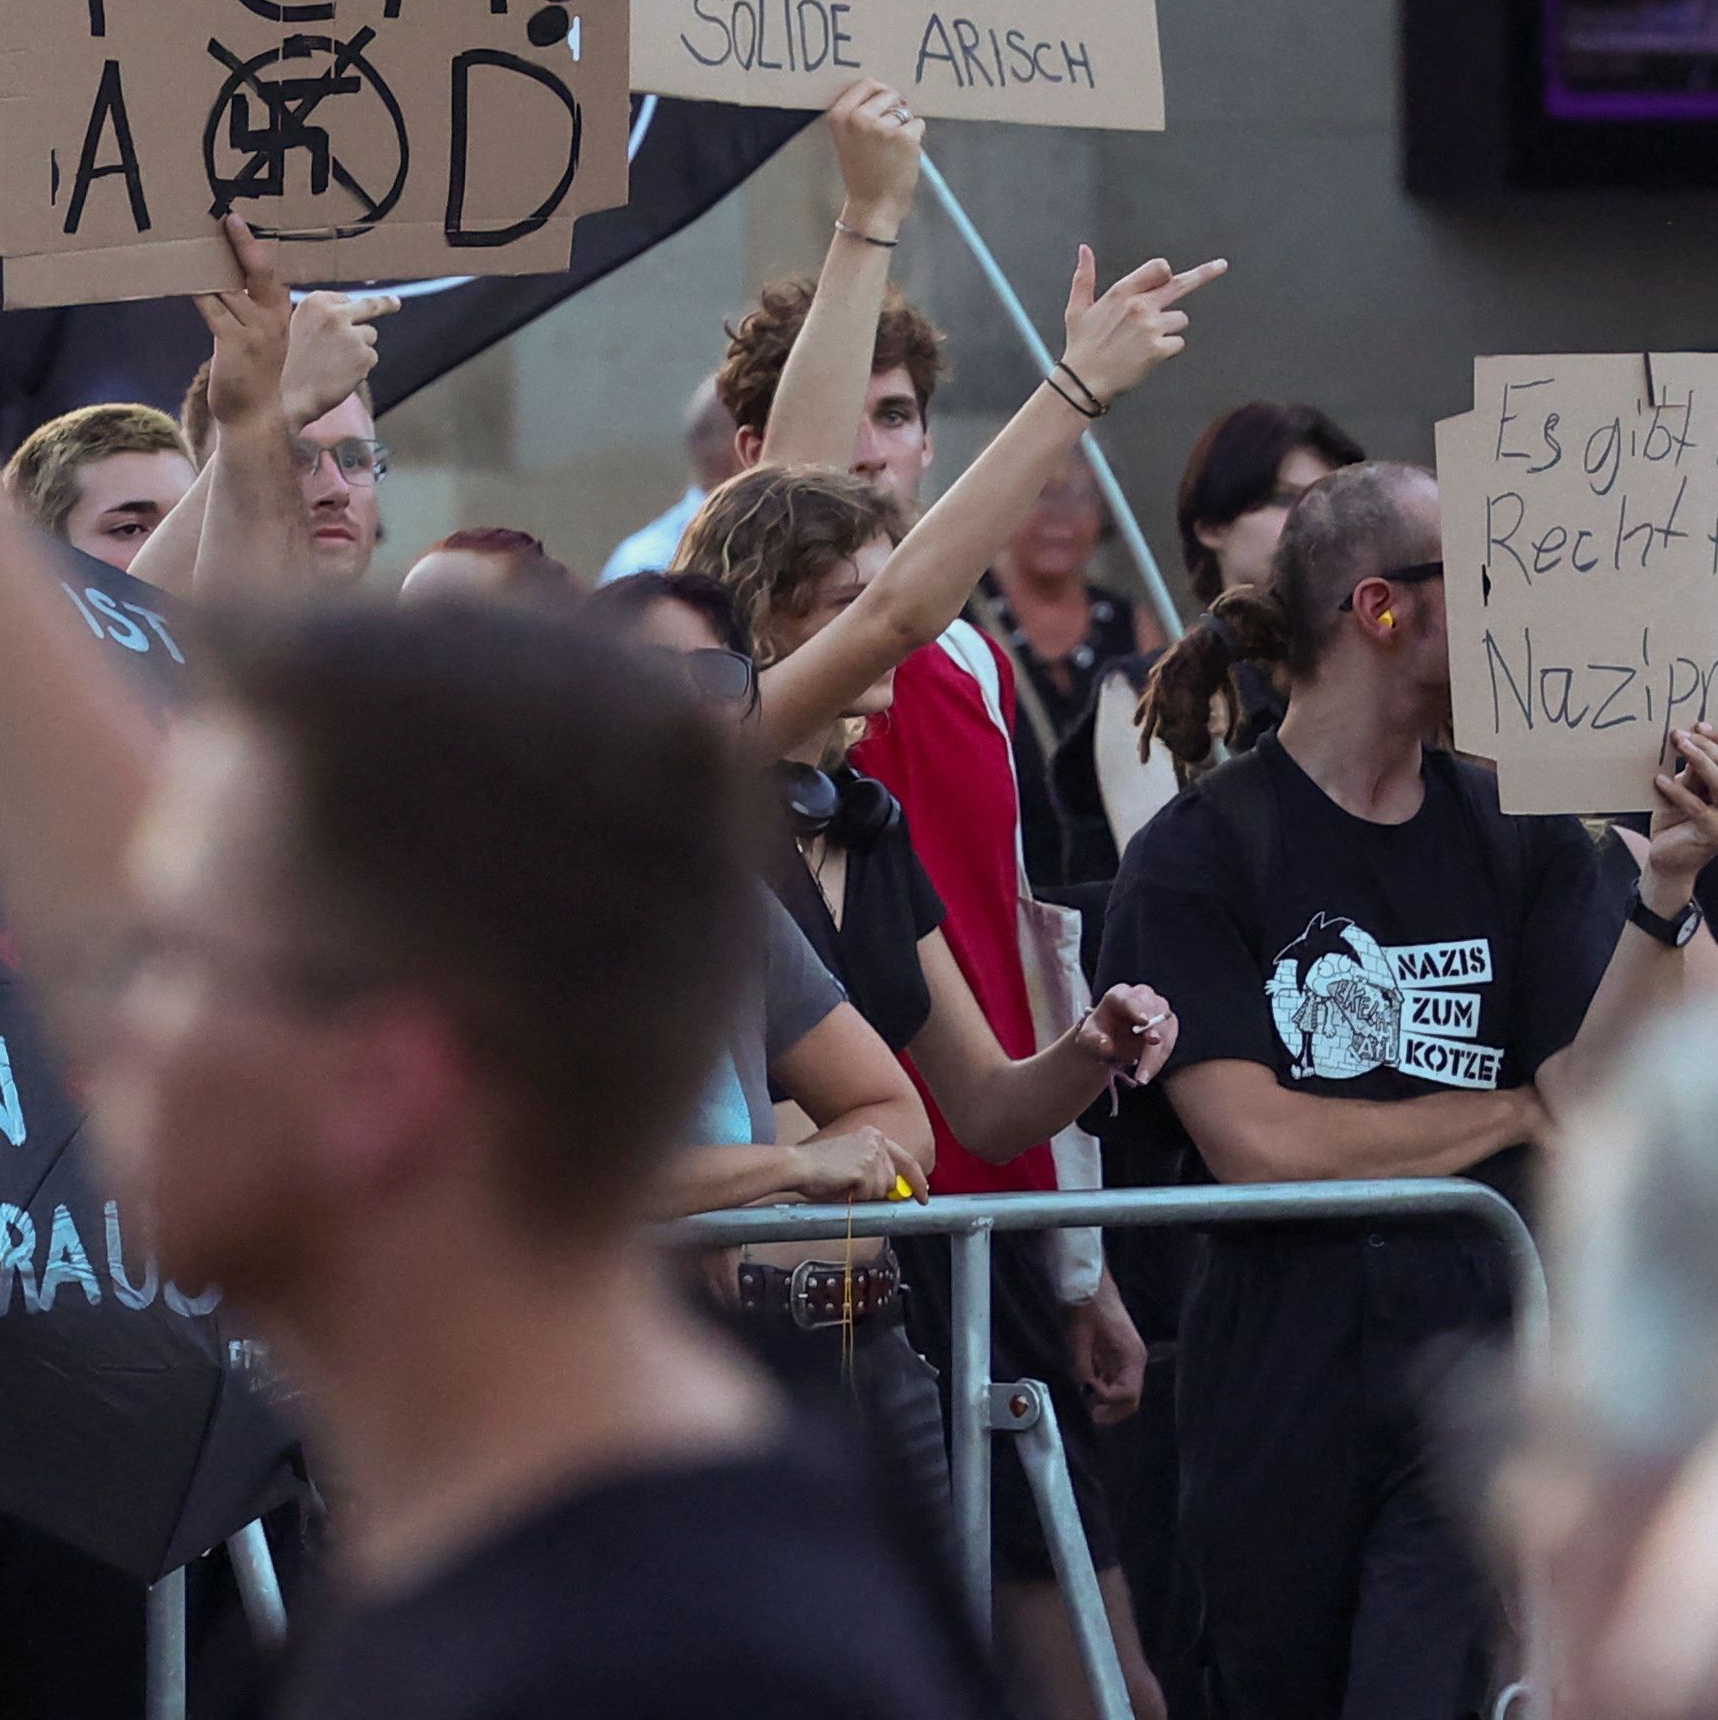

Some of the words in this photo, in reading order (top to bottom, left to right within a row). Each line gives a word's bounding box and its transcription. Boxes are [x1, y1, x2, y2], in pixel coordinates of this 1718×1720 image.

[915, 11, 1096, 90] ARISCH
[1494, 378, 1562, 474] Es
[1584, 384, 1697, 496] gibt
[1485, 475, 1689, 586] Recht
[1397, 945, 1487, 982] NAZIS
[1411, 995, 1474, 1030] ZUM
[1404, 1037, 1498, 1084] KOTZE
